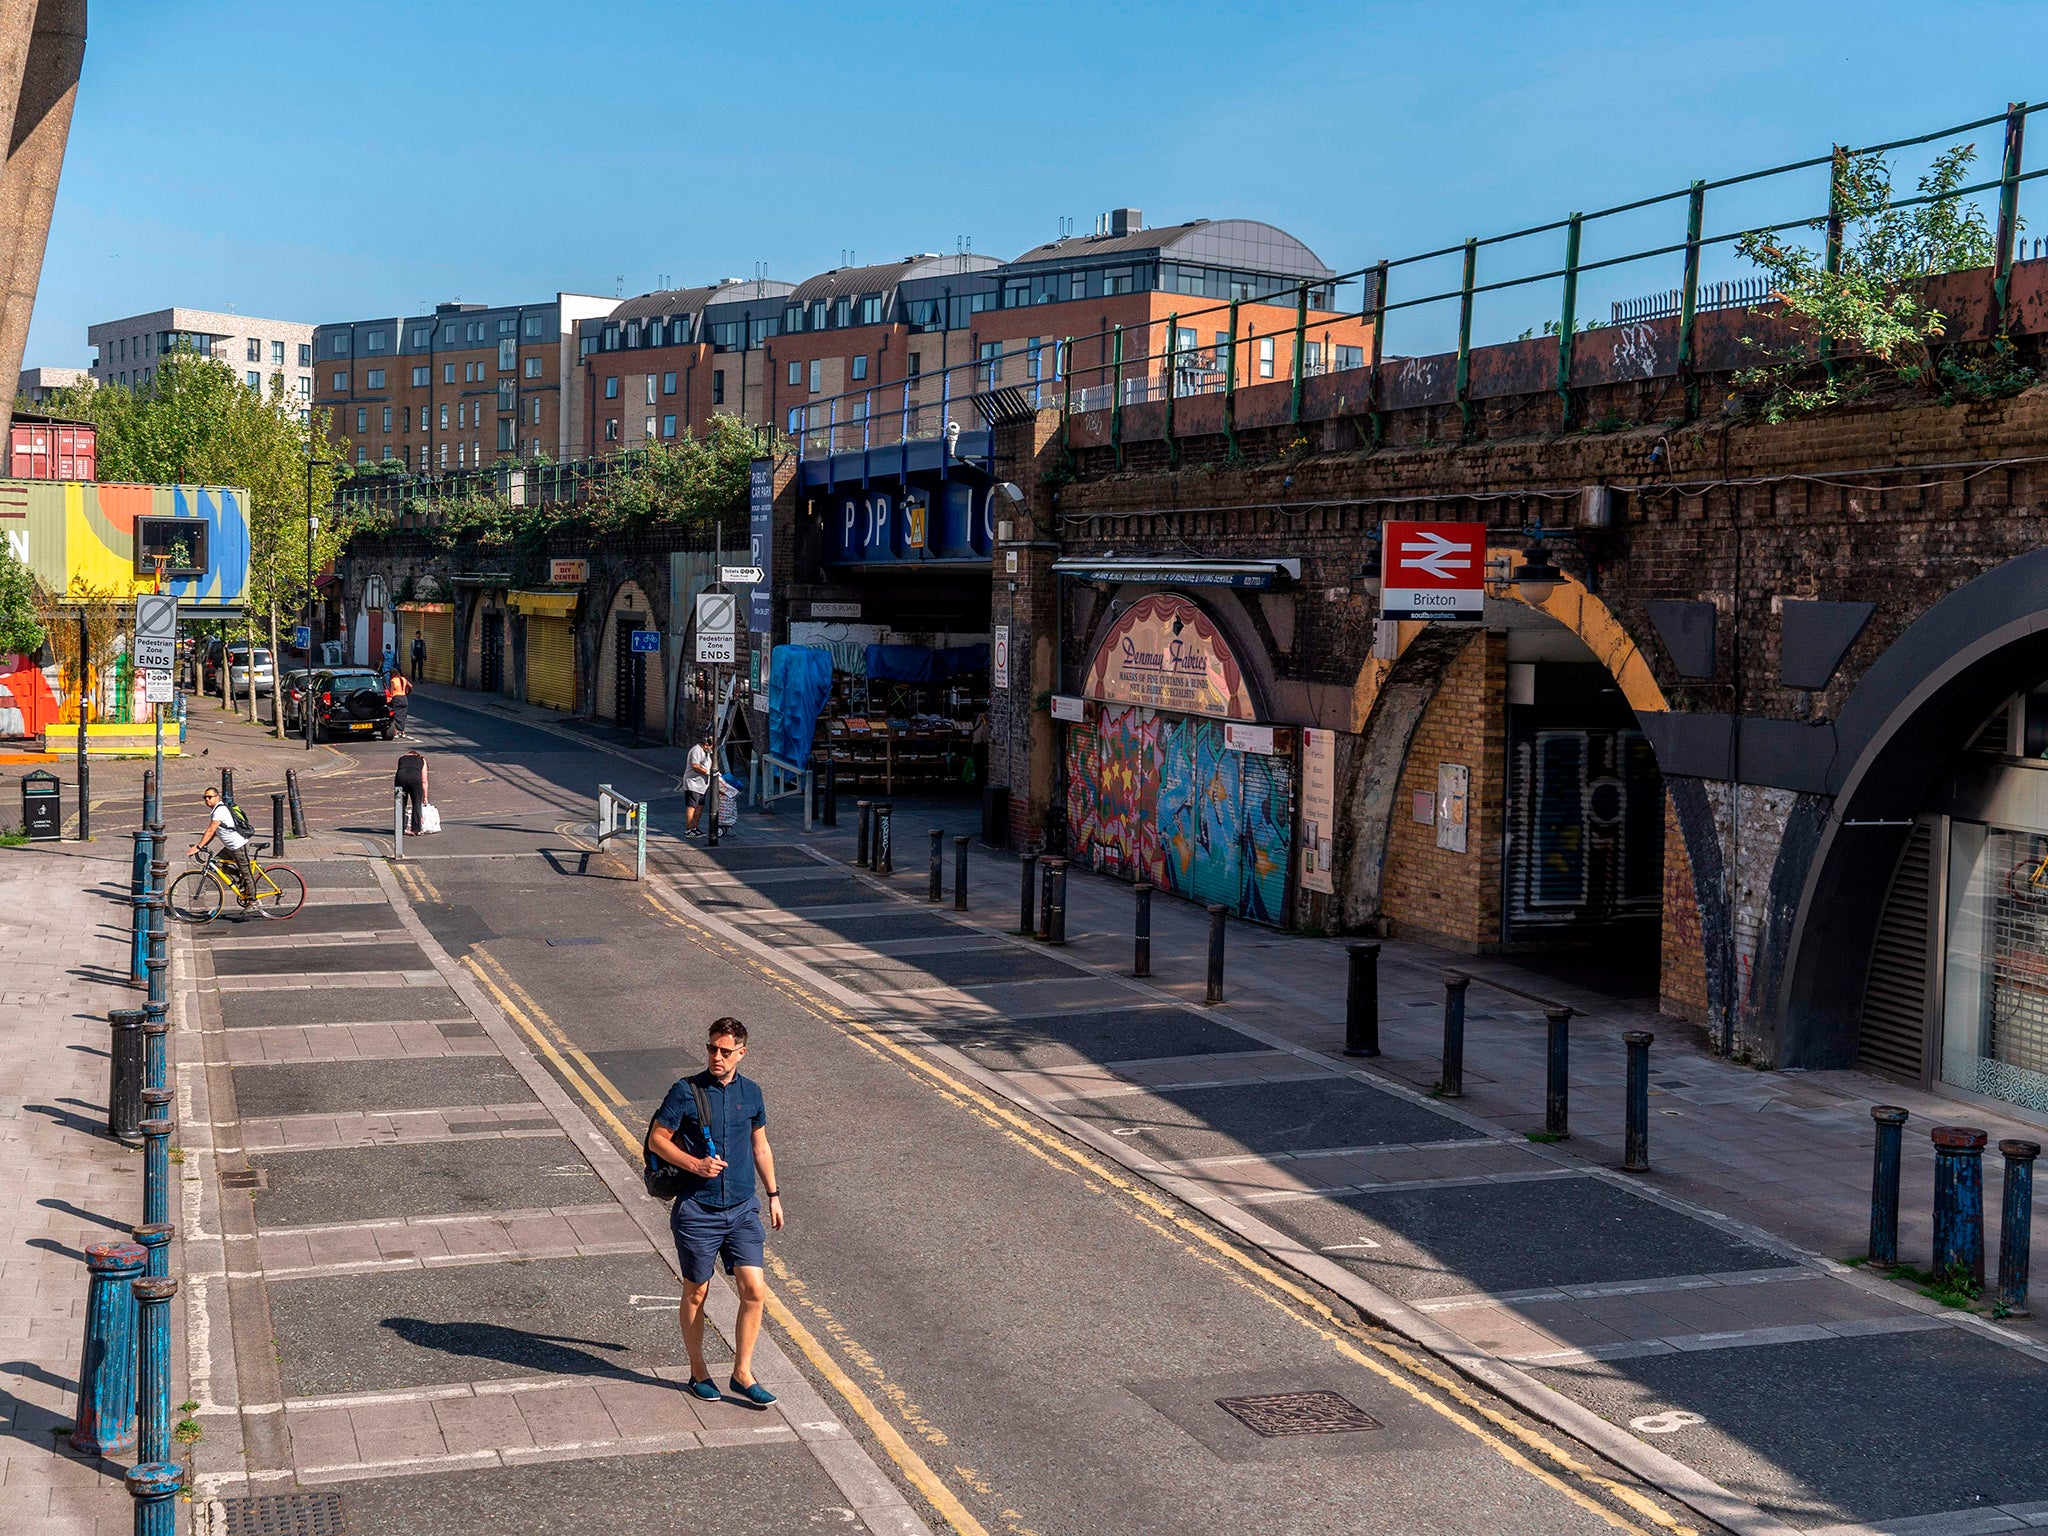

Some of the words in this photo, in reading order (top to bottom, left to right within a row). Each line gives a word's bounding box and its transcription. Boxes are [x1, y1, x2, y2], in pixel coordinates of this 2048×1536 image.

[752, 486, 760, 498] CAR
[1413, 593, 1456, 606] Brixton
[137, 638, 173, 647] Pedestrian
[139, 655, 170, 666] ENDS
[701, 651, 730, 660] ENDS
[1122, 636, 1164, 673] Denmay
[1169, 638, 1208, 673] Fabrics
[1119, 671, 1138, 682] MAKERS
[1139, 673, 1146, 682] OF
[1147, 674, 1158, 685] FINE
[1159, 675, 1184, 686] CURTAINS
[1191, 678, 1209, 689] BLINDS
[1130, 683, 1140, 693] NET
[1319, 1236, 1381, 1251] 7
[1629, 1410, 1707, 1434] 8
